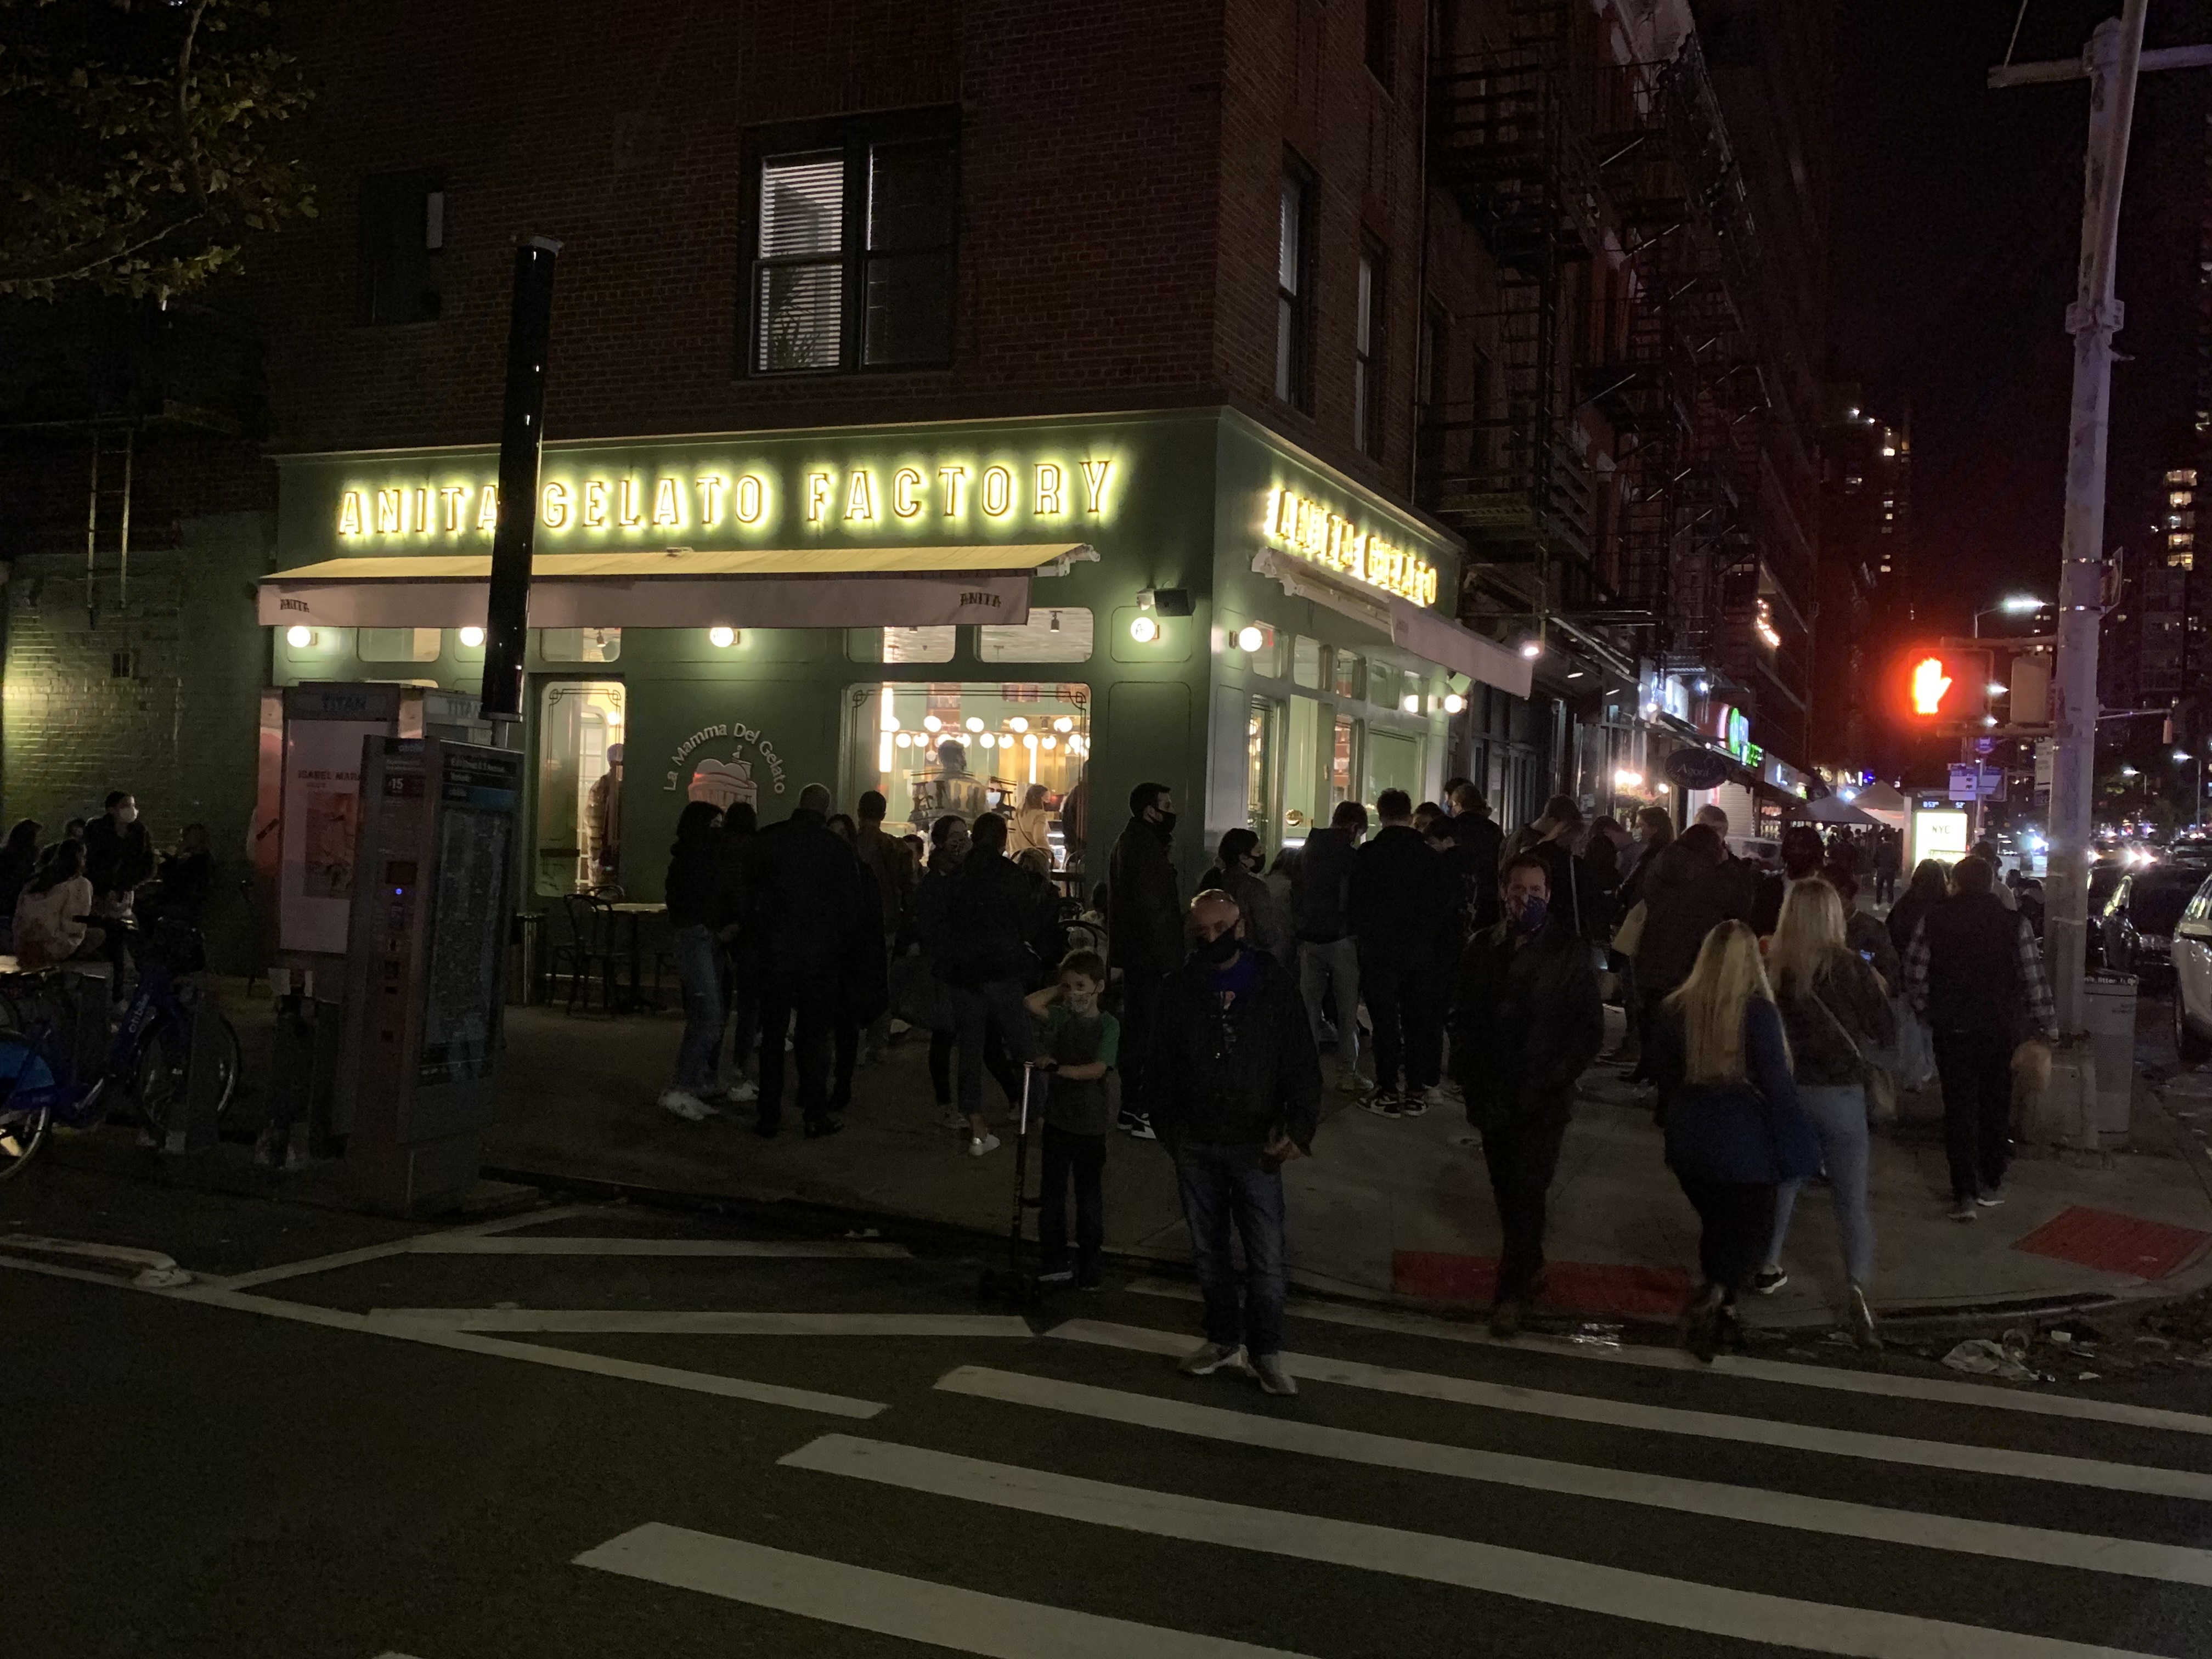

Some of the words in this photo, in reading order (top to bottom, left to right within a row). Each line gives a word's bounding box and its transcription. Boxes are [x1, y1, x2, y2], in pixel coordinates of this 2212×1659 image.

[338, 484, 498, 534] ANITA
[542, 475, 762, 528] GELATO
[807, 461, 1112, 522] FACTORY
[280, 599, 310, 613] ANITA
[960, 592, 1001, 607] ANITA
[663, 771, 679, 791] La
[672, 724, 727, 766] Mamma
[733, 723, 761, 744] Del
[759, 741, 786, 794] Gelato
[298, 770, 331, 780] ISABEL
[1932, 825, 1950, 834] NYC
